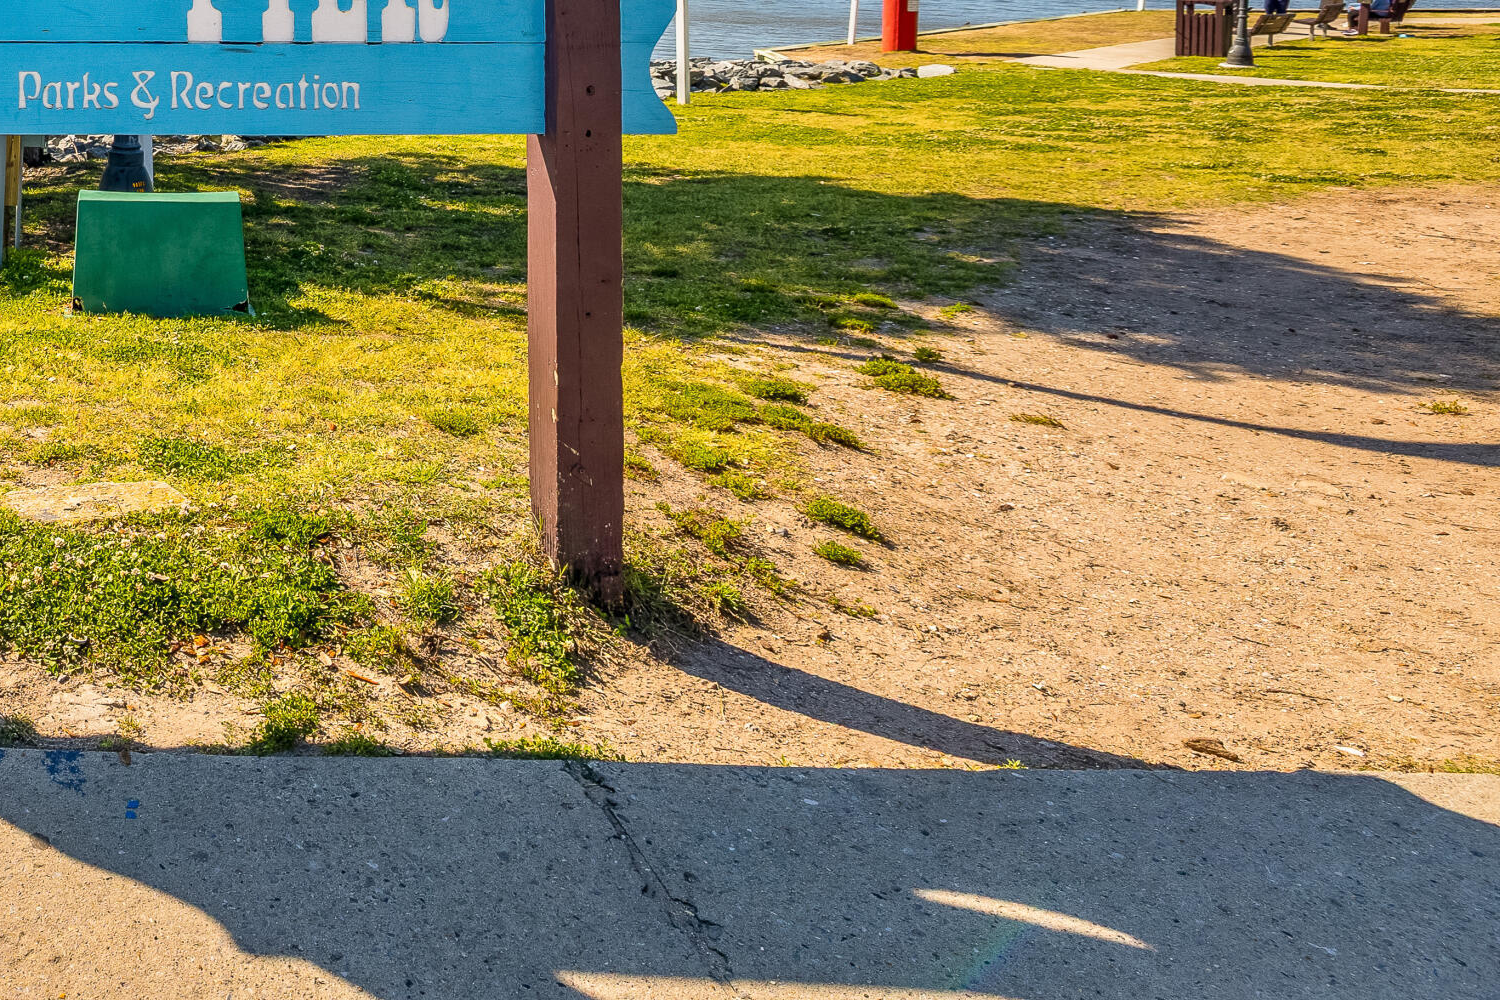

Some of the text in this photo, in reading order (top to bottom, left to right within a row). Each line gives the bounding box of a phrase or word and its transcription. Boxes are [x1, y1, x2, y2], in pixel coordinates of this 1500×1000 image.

[17, 70, 120, 111] Parks
[129, 69, 161, 119] &
[169, 70, 360, 111] Recreation
